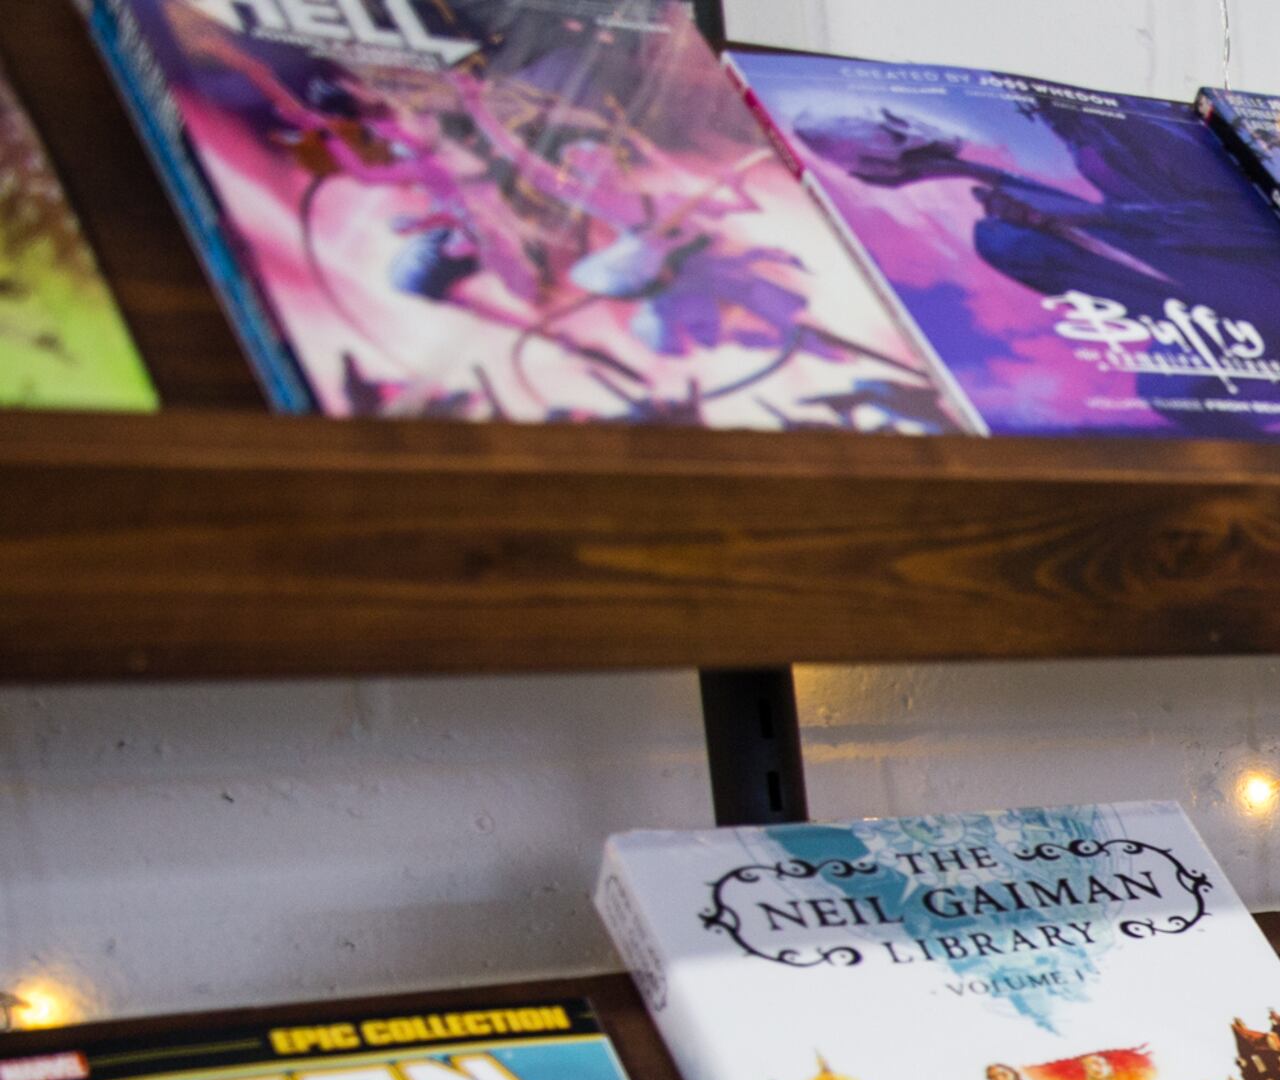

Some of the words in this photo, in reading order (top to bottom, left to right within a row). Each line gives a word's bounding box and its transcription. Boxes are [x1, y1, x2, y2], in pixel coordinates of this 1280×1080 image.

[979, 76, 1029, 92] JOSS
[1031, 83, 1120, 108] WHEDON
[1042, 290, 1264, 378] Buffy
[896, 846, 999, 875] THE
[758, 894, 905, 935] NEIL
[922, 871, 1165, 923] GAIMAN
[882, 920, 1100, 967] LIBRARY
[945, 970, 1068, 998] VOLUME
[270, 1025, 362, 1055] EPIC
[360, 1004, 572, 1047] COLLECTION
